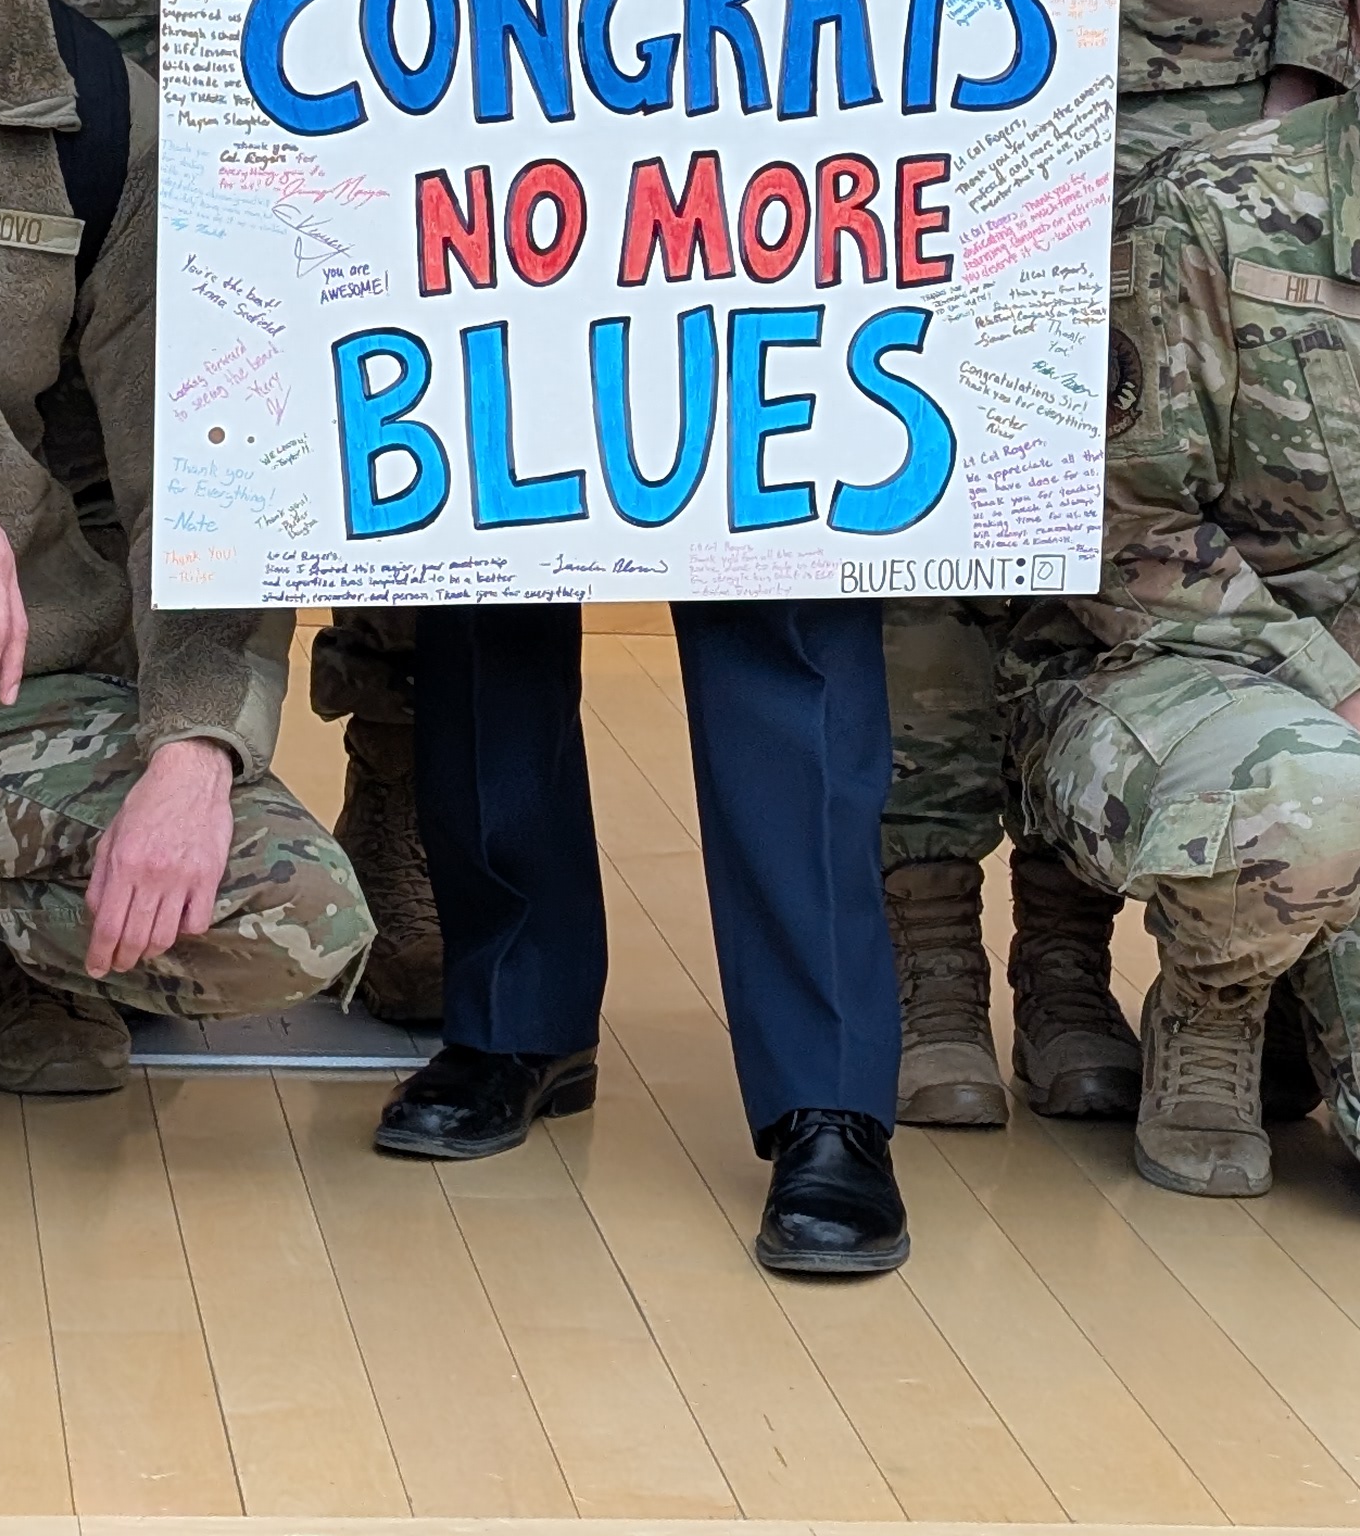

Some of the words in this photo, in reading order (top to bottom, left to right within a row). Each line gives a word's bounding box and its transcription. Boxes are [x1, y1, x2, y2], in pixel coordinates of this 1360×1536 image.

[955, 167, 987, 195] Thank
[988, 153, 1010, 184] you
[1010, 138, 1026, 155] for
[1052, 104, 1074, 121] the
[1073, 74, 1115, 107] amazing
[966, 141, 986, 160] Col
[1009, 155, 1030, 177] and
[1029, 140, 1054, 159] more
[981, 184, 1012, 212] mentor
[1013, 167, 1035, 188] that
[1037, 154, 1055, 180] you
[1022, 191, 1053, 212] Thank
[1052, 183, 1071, 200] you
[416, 158, 586, 297] NO
[617, 151, 954, 290] MORE
[181, 253, 219, 284] You're
[222, 276, 243, 297] the
[319, 268, 390, 305] AWESOME!
[322, 266, 345, 285] you
[348, 263, 371, 277] are
[1286, 275, 1325, 303] HILL
[191, 280, 228, 310] Anna
[203, 337, 247, 375] forward
[173, 408, 189, 422] to
[192, 384, 229, 412] seeing
[223, 367, 250, 386] the
[959, 360, 1056, 405] Congratulations
[959, 374, 991, 396] Thank
[992, 388, 1012, 404] you
[1015, 395, 1035, 410] for
[332, 305, 957, 539] BLUES
[173, 457, 219, 477] Thank
[220, 467, 255, 486] you
[966, 472, 982, 484] We
[987, 458, 1053, 483] appreciate
[1061, 453, 1074, 465] all
[1083, 449, 1104, 462] that
[980, 450, 1000, 464] Col
[167, 478, 187, 495] for
[968, 486, 988, 501] you
[994, 482, 1022, 492] have
[1063, 470, 1079, 480] for
[971, 496, 1005, 510] Thank
[1011, 493, 1031, 507] you
[1037, 490, 1054, 500] for
[1058, 483, 1101, 498] teaching
[255, 509, 285, 529] Thank
[973, 518, 1010, 533] making
[164, 549, 201, 566] Thank
[841, 559, 917, 593] BLUES
[924, 556, 1026, 591] COUNT:
[1037, 561, 1054, 580] 0
